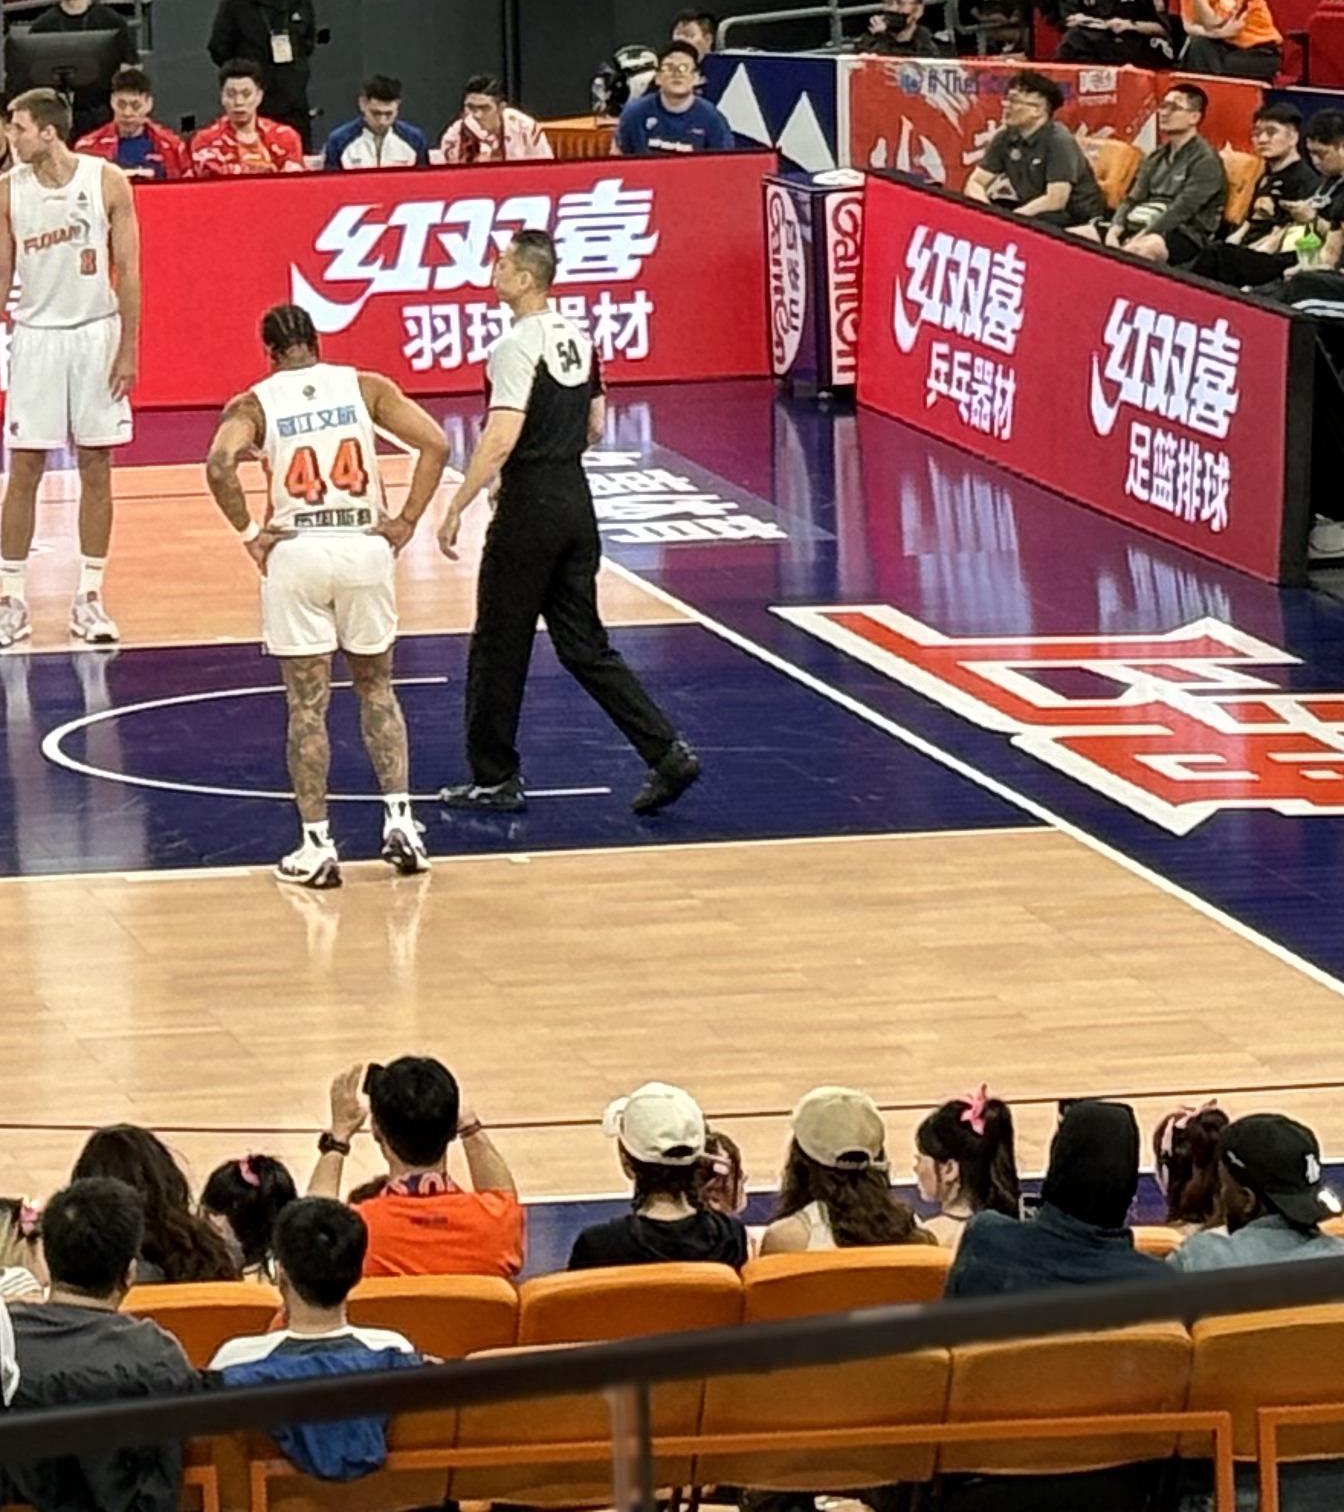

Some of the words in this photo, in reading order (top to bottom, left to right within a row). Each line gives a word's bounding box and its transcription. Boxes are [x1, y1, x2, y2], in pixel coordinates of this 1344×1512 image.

[291, 178, 660, 333] 红双喜
[894, 225, 1027, 354] 红双喜
[402, 290, 654, 371] 羽球材
[1091, 298, 1241, 439] 红双喜
[925, 342, 1016, 440] 乒乓器材
[284, 436, 370, 506] 44
[1124, 421, 1231, 533] 足篮排球
